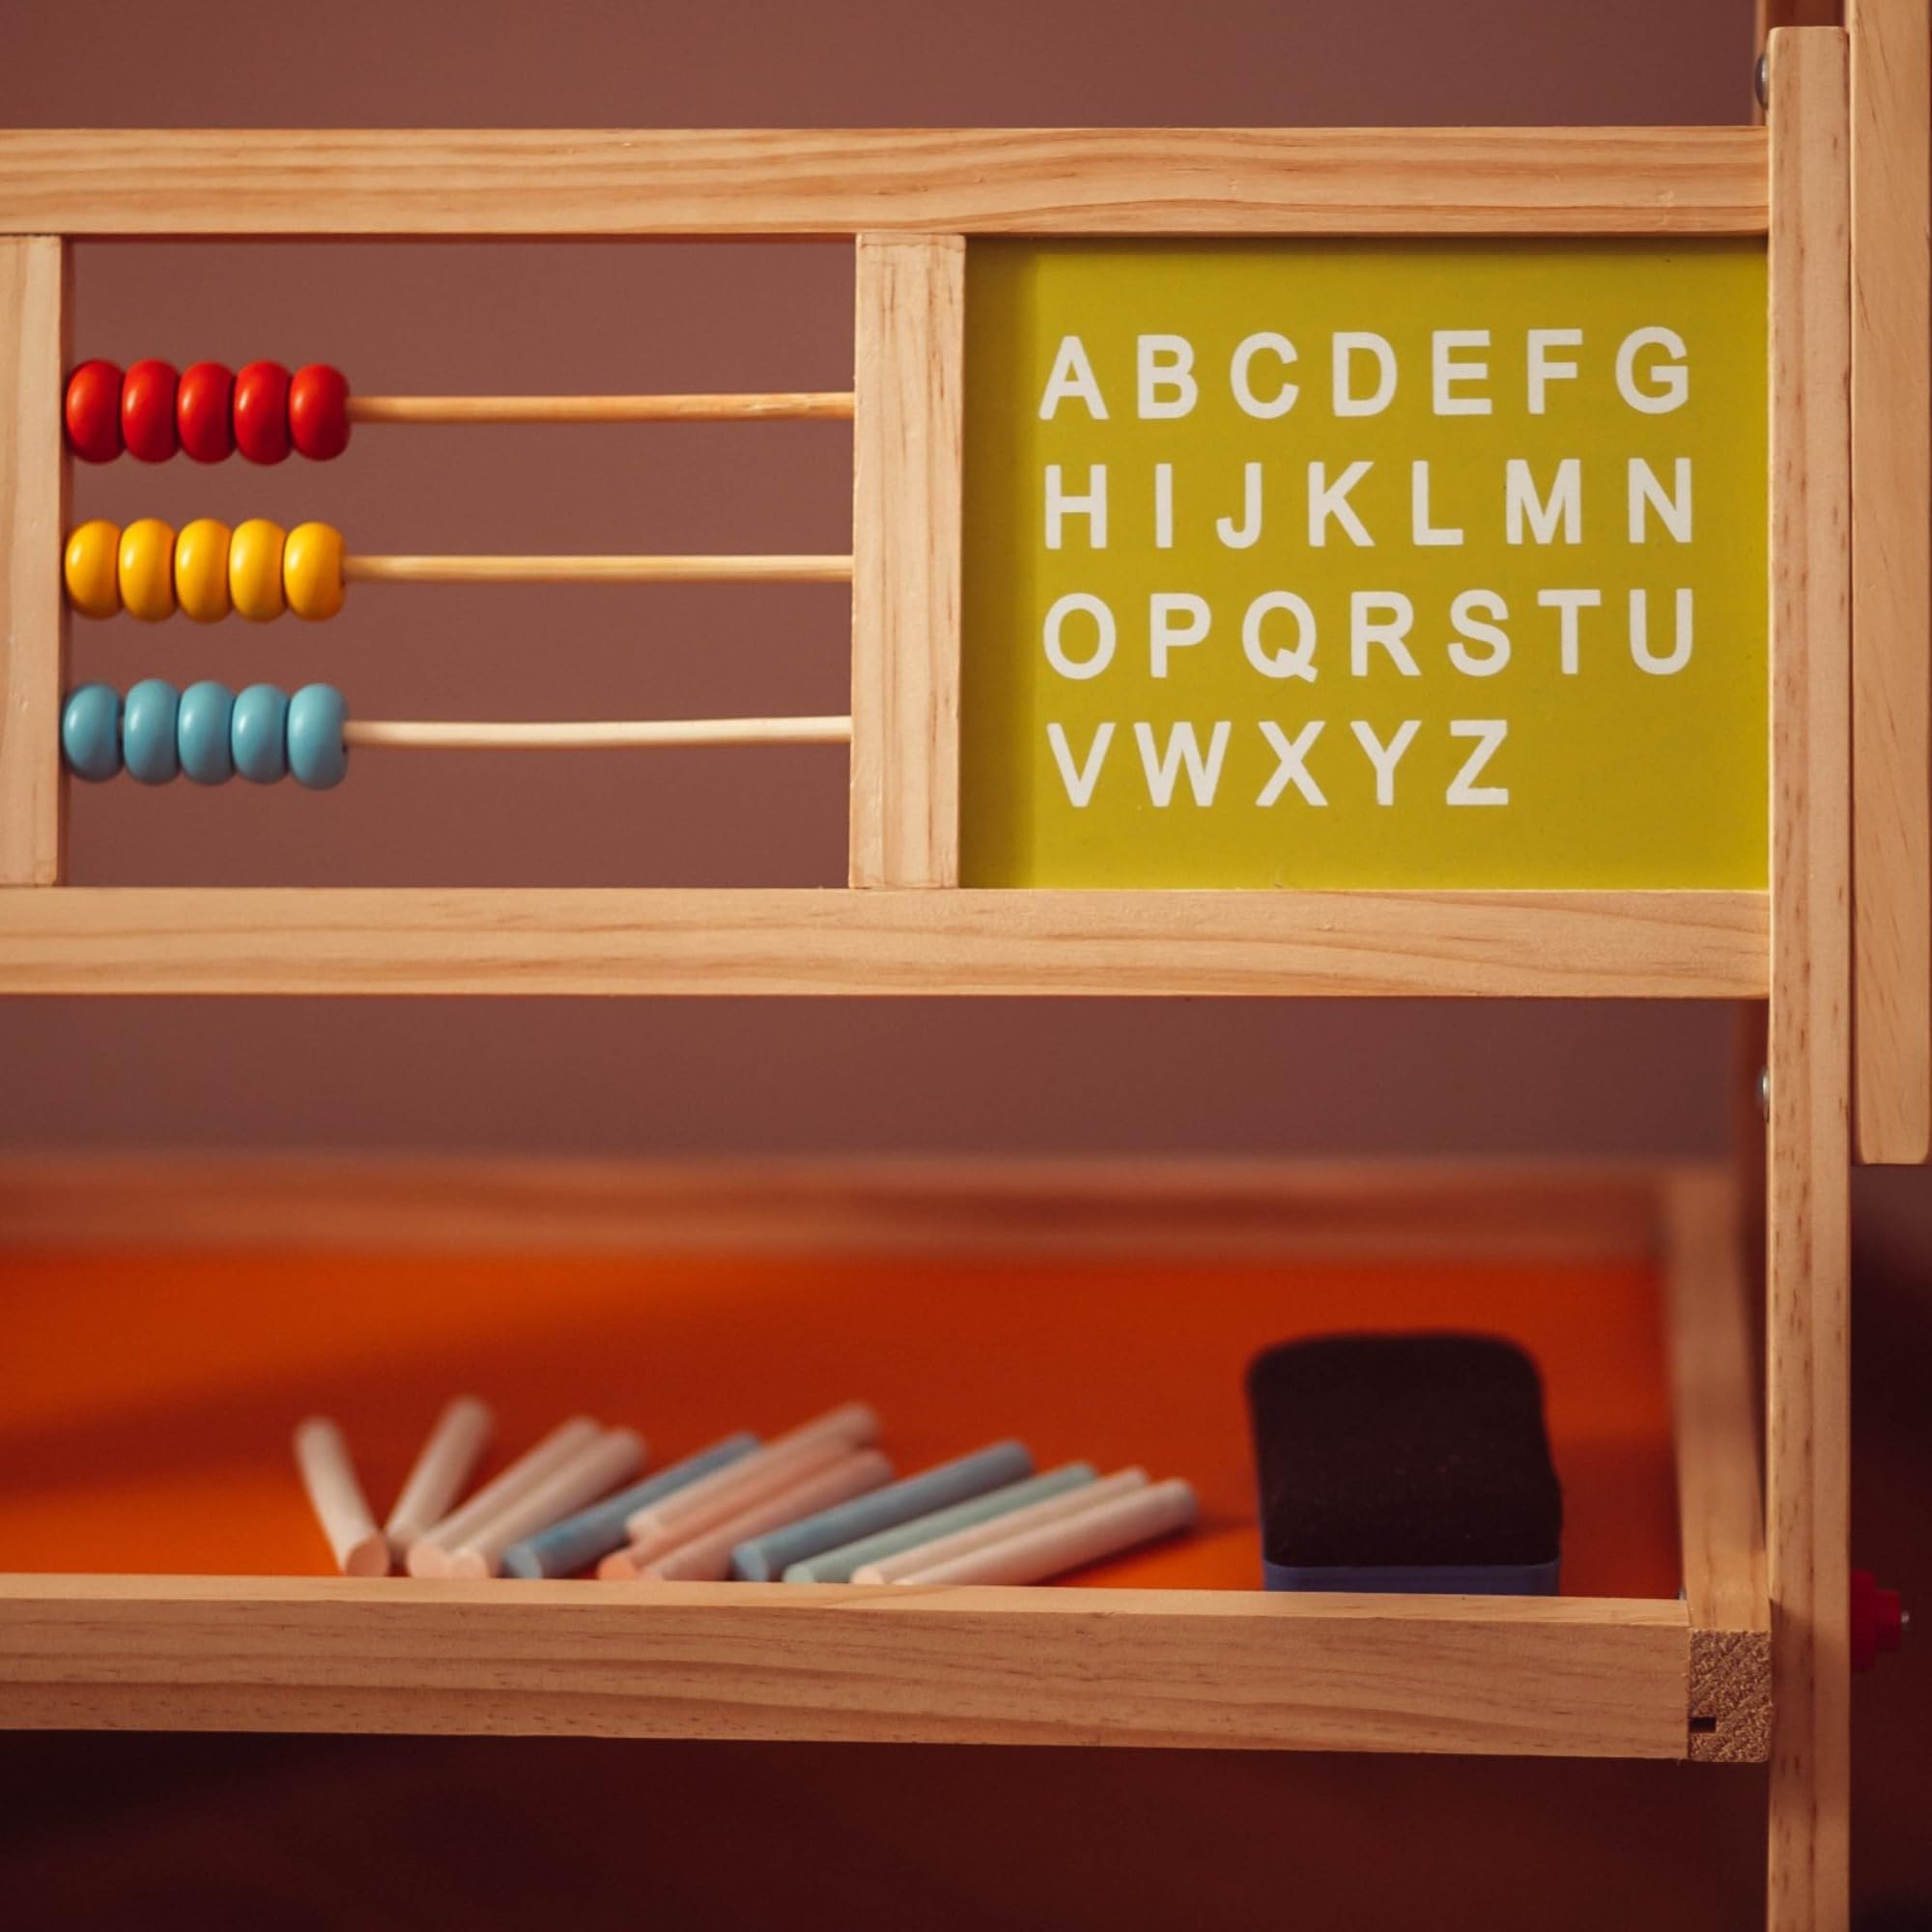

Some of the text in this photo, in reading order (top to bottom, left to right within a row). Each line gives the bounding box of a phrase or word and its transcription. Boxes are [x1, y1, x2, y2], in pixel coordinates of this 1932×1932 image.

[1039, 327, 1688, 420] A B C D E F G
[1045, 459, 1691, 549] H I J K L M N
[1044, 589, 1692, 682] O P Q R S T U
[1047, 721, 1508, 807] V W X Y Z
